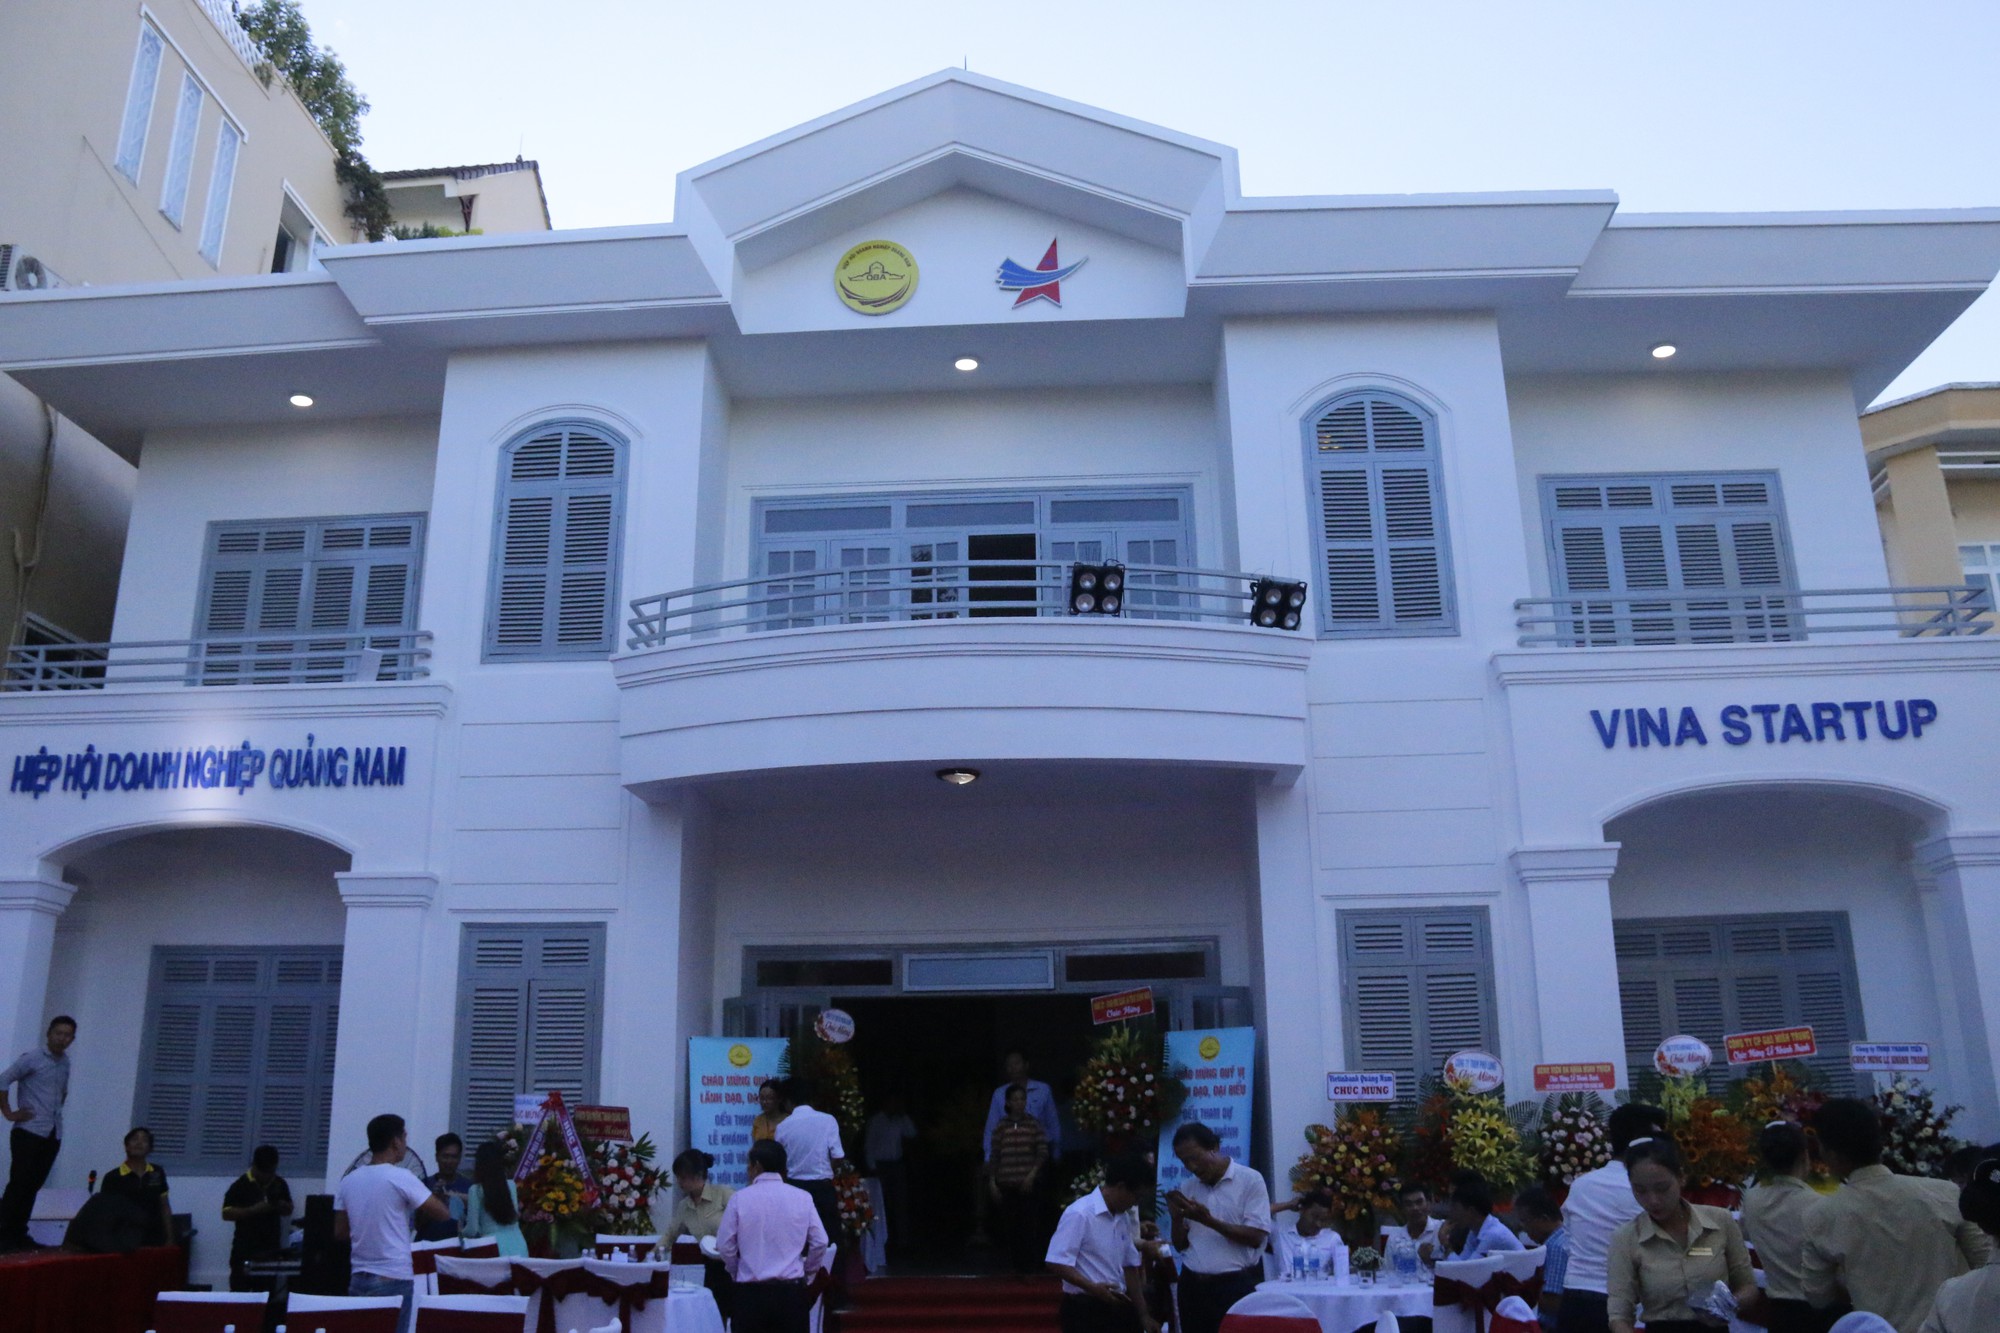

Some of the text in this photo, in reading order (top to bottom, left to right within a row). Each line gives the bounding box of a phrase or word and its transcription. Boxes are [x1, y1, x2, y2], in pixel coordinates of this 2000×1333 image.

[1589, 699, 1938, 748] VINA STARTUP
[10, 733, 406, 800] HIỆP HỘI DOANH NGHIỆP QUẢNG NAM
